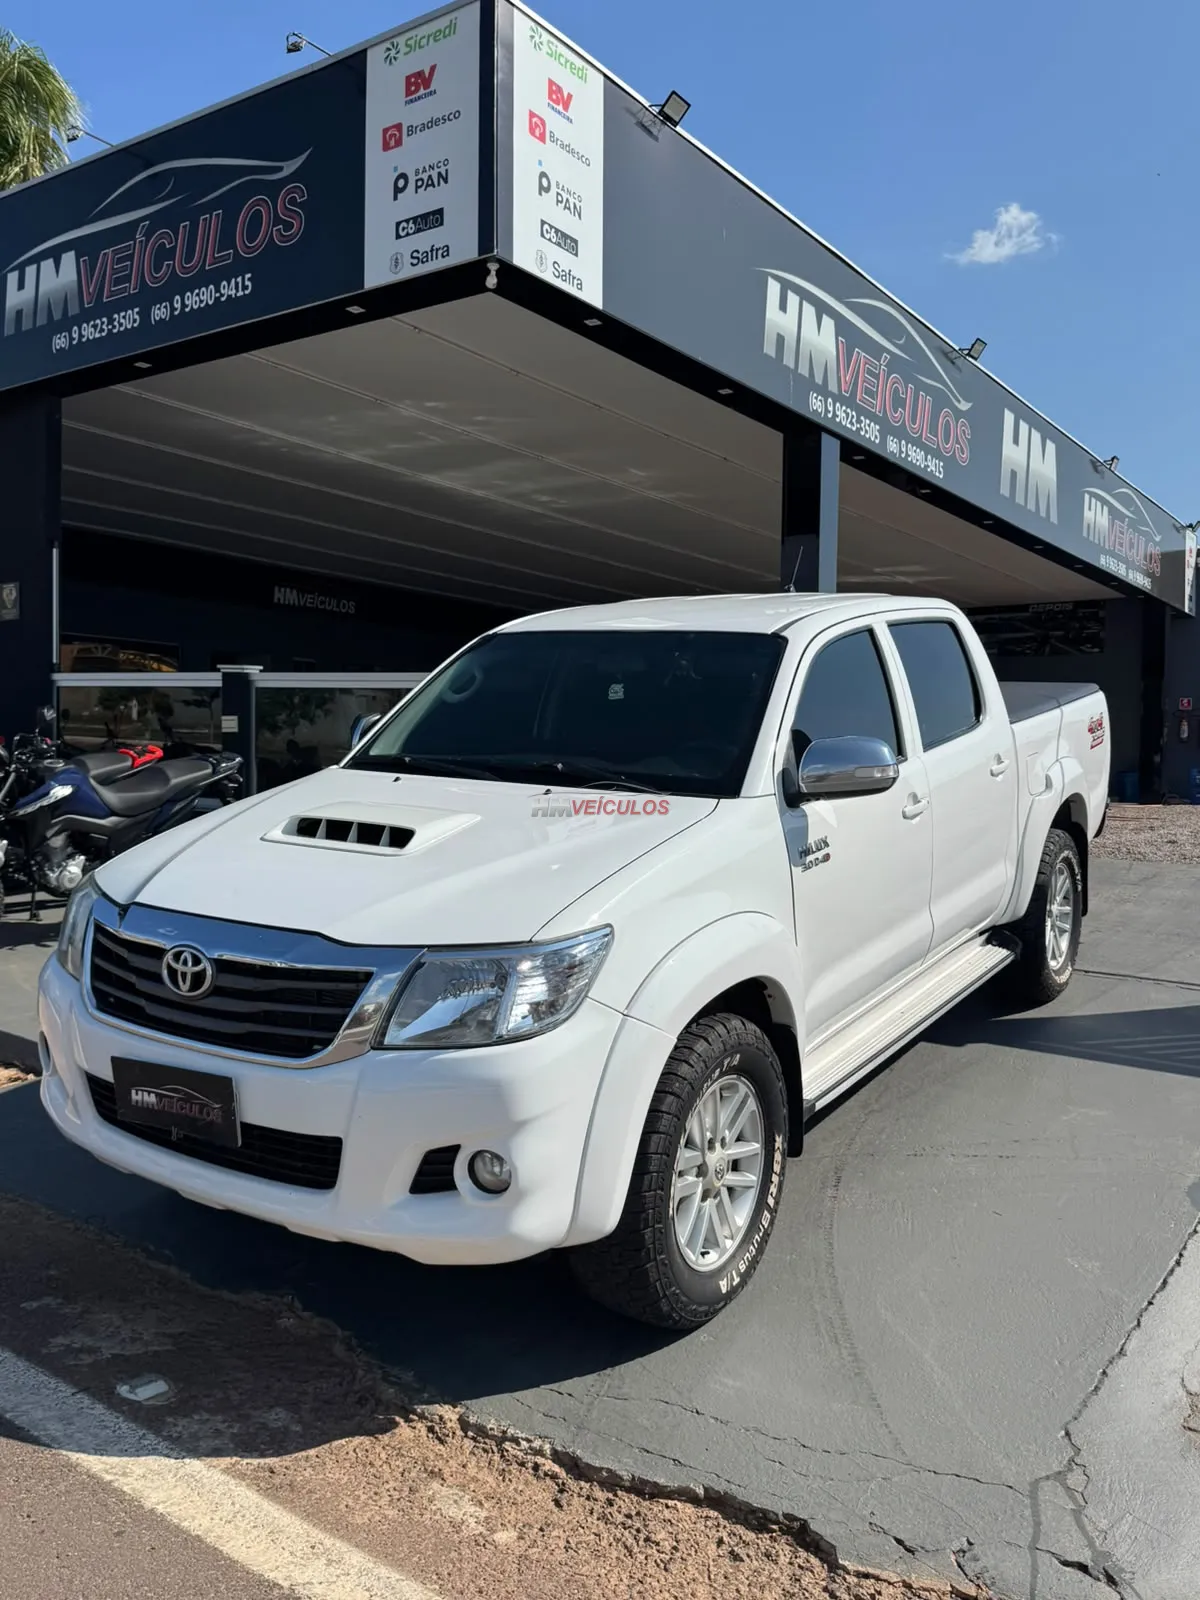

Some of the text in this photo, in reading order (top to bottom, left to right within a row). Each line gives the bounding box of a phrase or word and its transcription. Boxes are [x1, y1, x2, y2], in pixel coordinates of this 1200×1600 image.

[404, 17, 458, 56] Sicredi
[546, 39, 588, 84] Sicredi
[404, 64, 437, 98] BV
[404, 89, 437, 106] FINANCEIRA
[548, 77, 573, 113] BV
[406, 109, 462, 137] Bradesco
[549, 131, 591, 167] Bradesco
[414, 158, 450, 176] BANCO
[414, 168, 449, 194] PAN
[555, 181, 583, 203] BANCO
[555, 192, 582, 221] PAN
[410, 244, 450, 267] Safra
[552, 261, 583, 291] Safra
[52, 273, 252, 353] (66) 9 9623-3505 (66) 9 9690-9415
[809, 391, 944, 479] (66) 9 9623-3505 (66) 9 9690-9415
[1000, 408, 1058, 525] HM
[738, 1209, 771, 1273] Brutus
